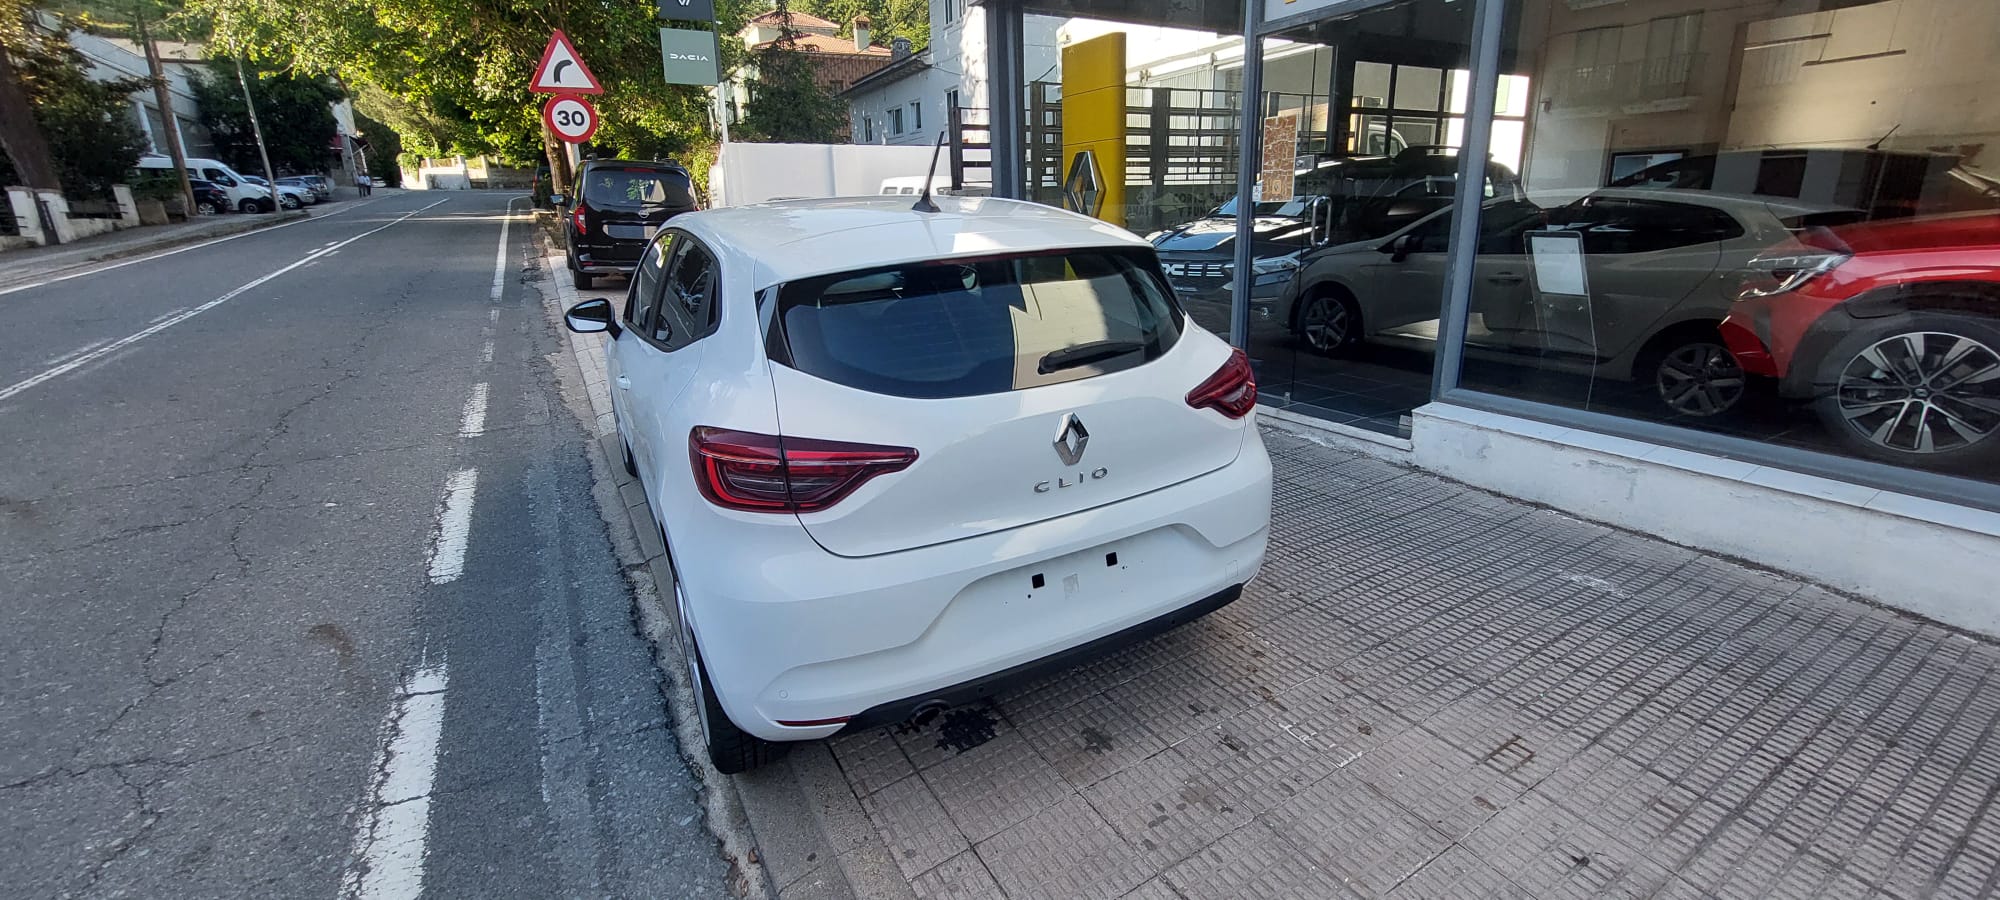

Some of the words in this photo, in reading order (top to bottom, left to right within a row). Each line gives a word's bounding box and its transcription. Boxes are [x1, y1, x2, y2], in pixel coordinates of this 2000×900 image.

[670, 53, 709, 61] DACIA
[557, 110, 585, 126] 30
[1034, 467, 1108, 493] CLIO
